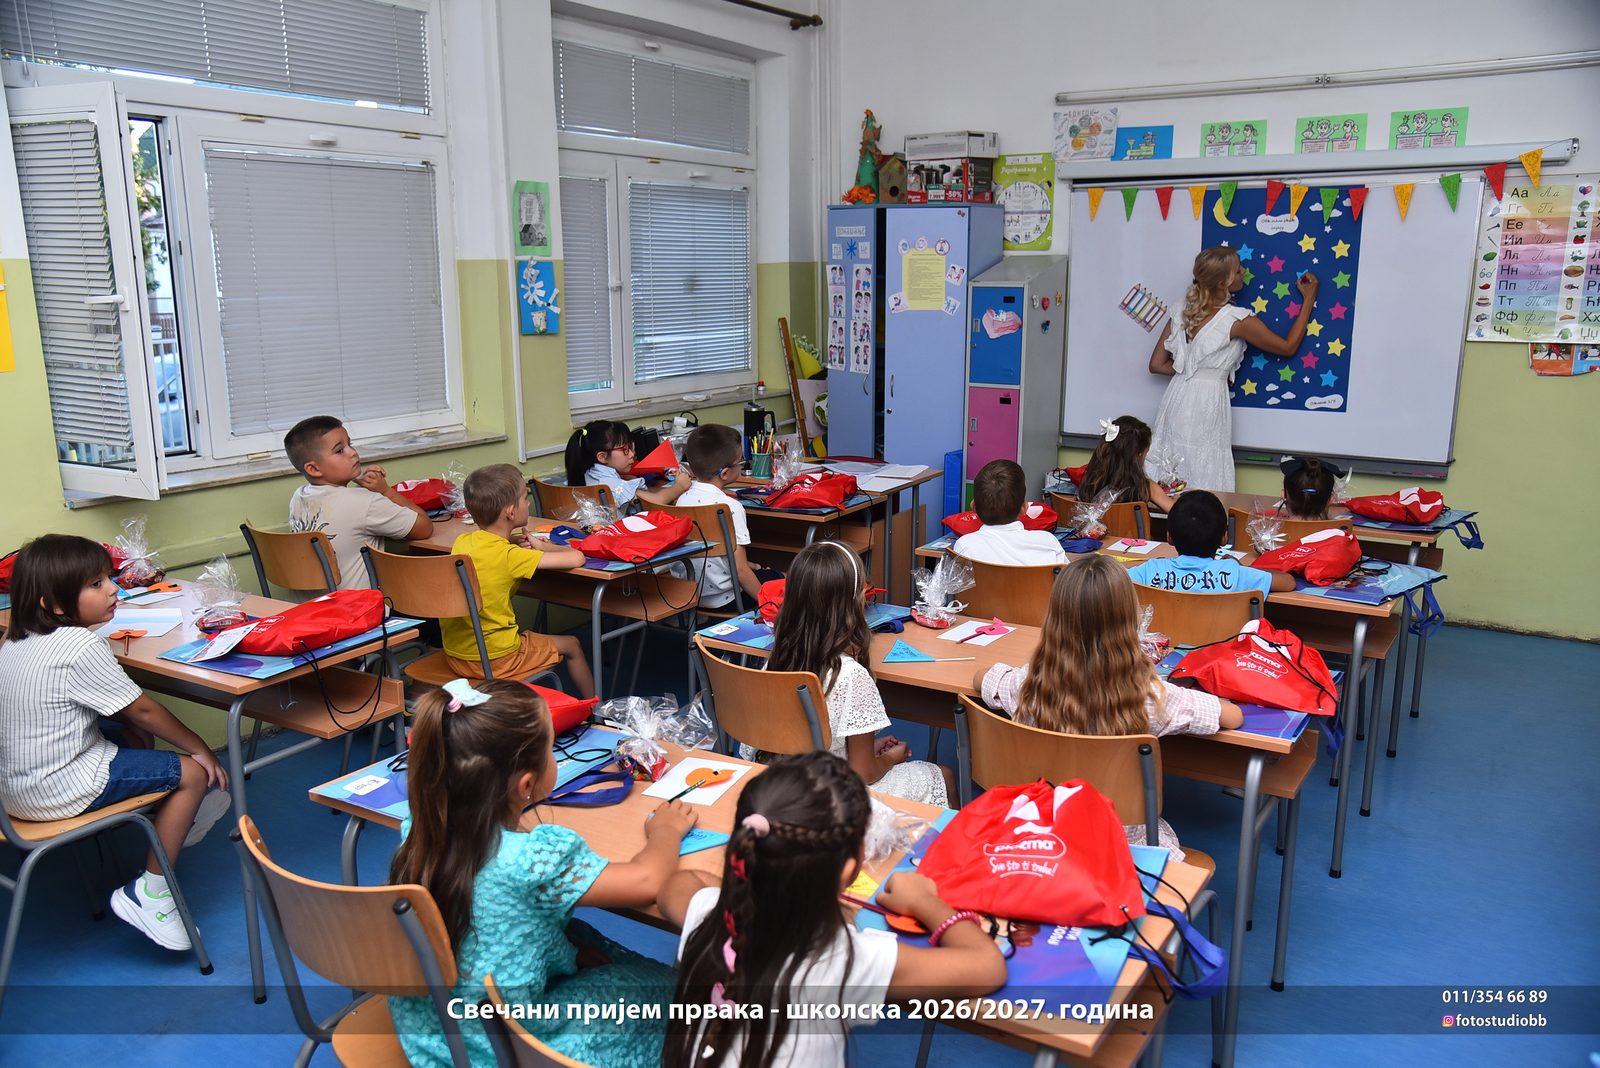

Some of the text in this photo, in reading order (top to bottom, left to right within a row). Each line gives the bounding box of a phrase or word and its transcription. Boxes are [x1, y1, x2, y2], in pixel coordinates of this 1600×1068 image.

[945, 190, 963, 198] -50%
[1510, 187, 1529, 198] Аа
[1506, 219, 1524, 230] Ее
[1504, 234, 1523, 245] Ии
[1503, 249, 1519, 260] Лл
[1500, 265, 1518, 275] Нн
[1498, 280, 1517, 291] Пп
[1498, 295, 1514, 306] Тт
[1495, 310, 1518, 323] Фф
[1493, 325, 1509, 335] Чч
[1151, 570, 1233, 590] SPORT
